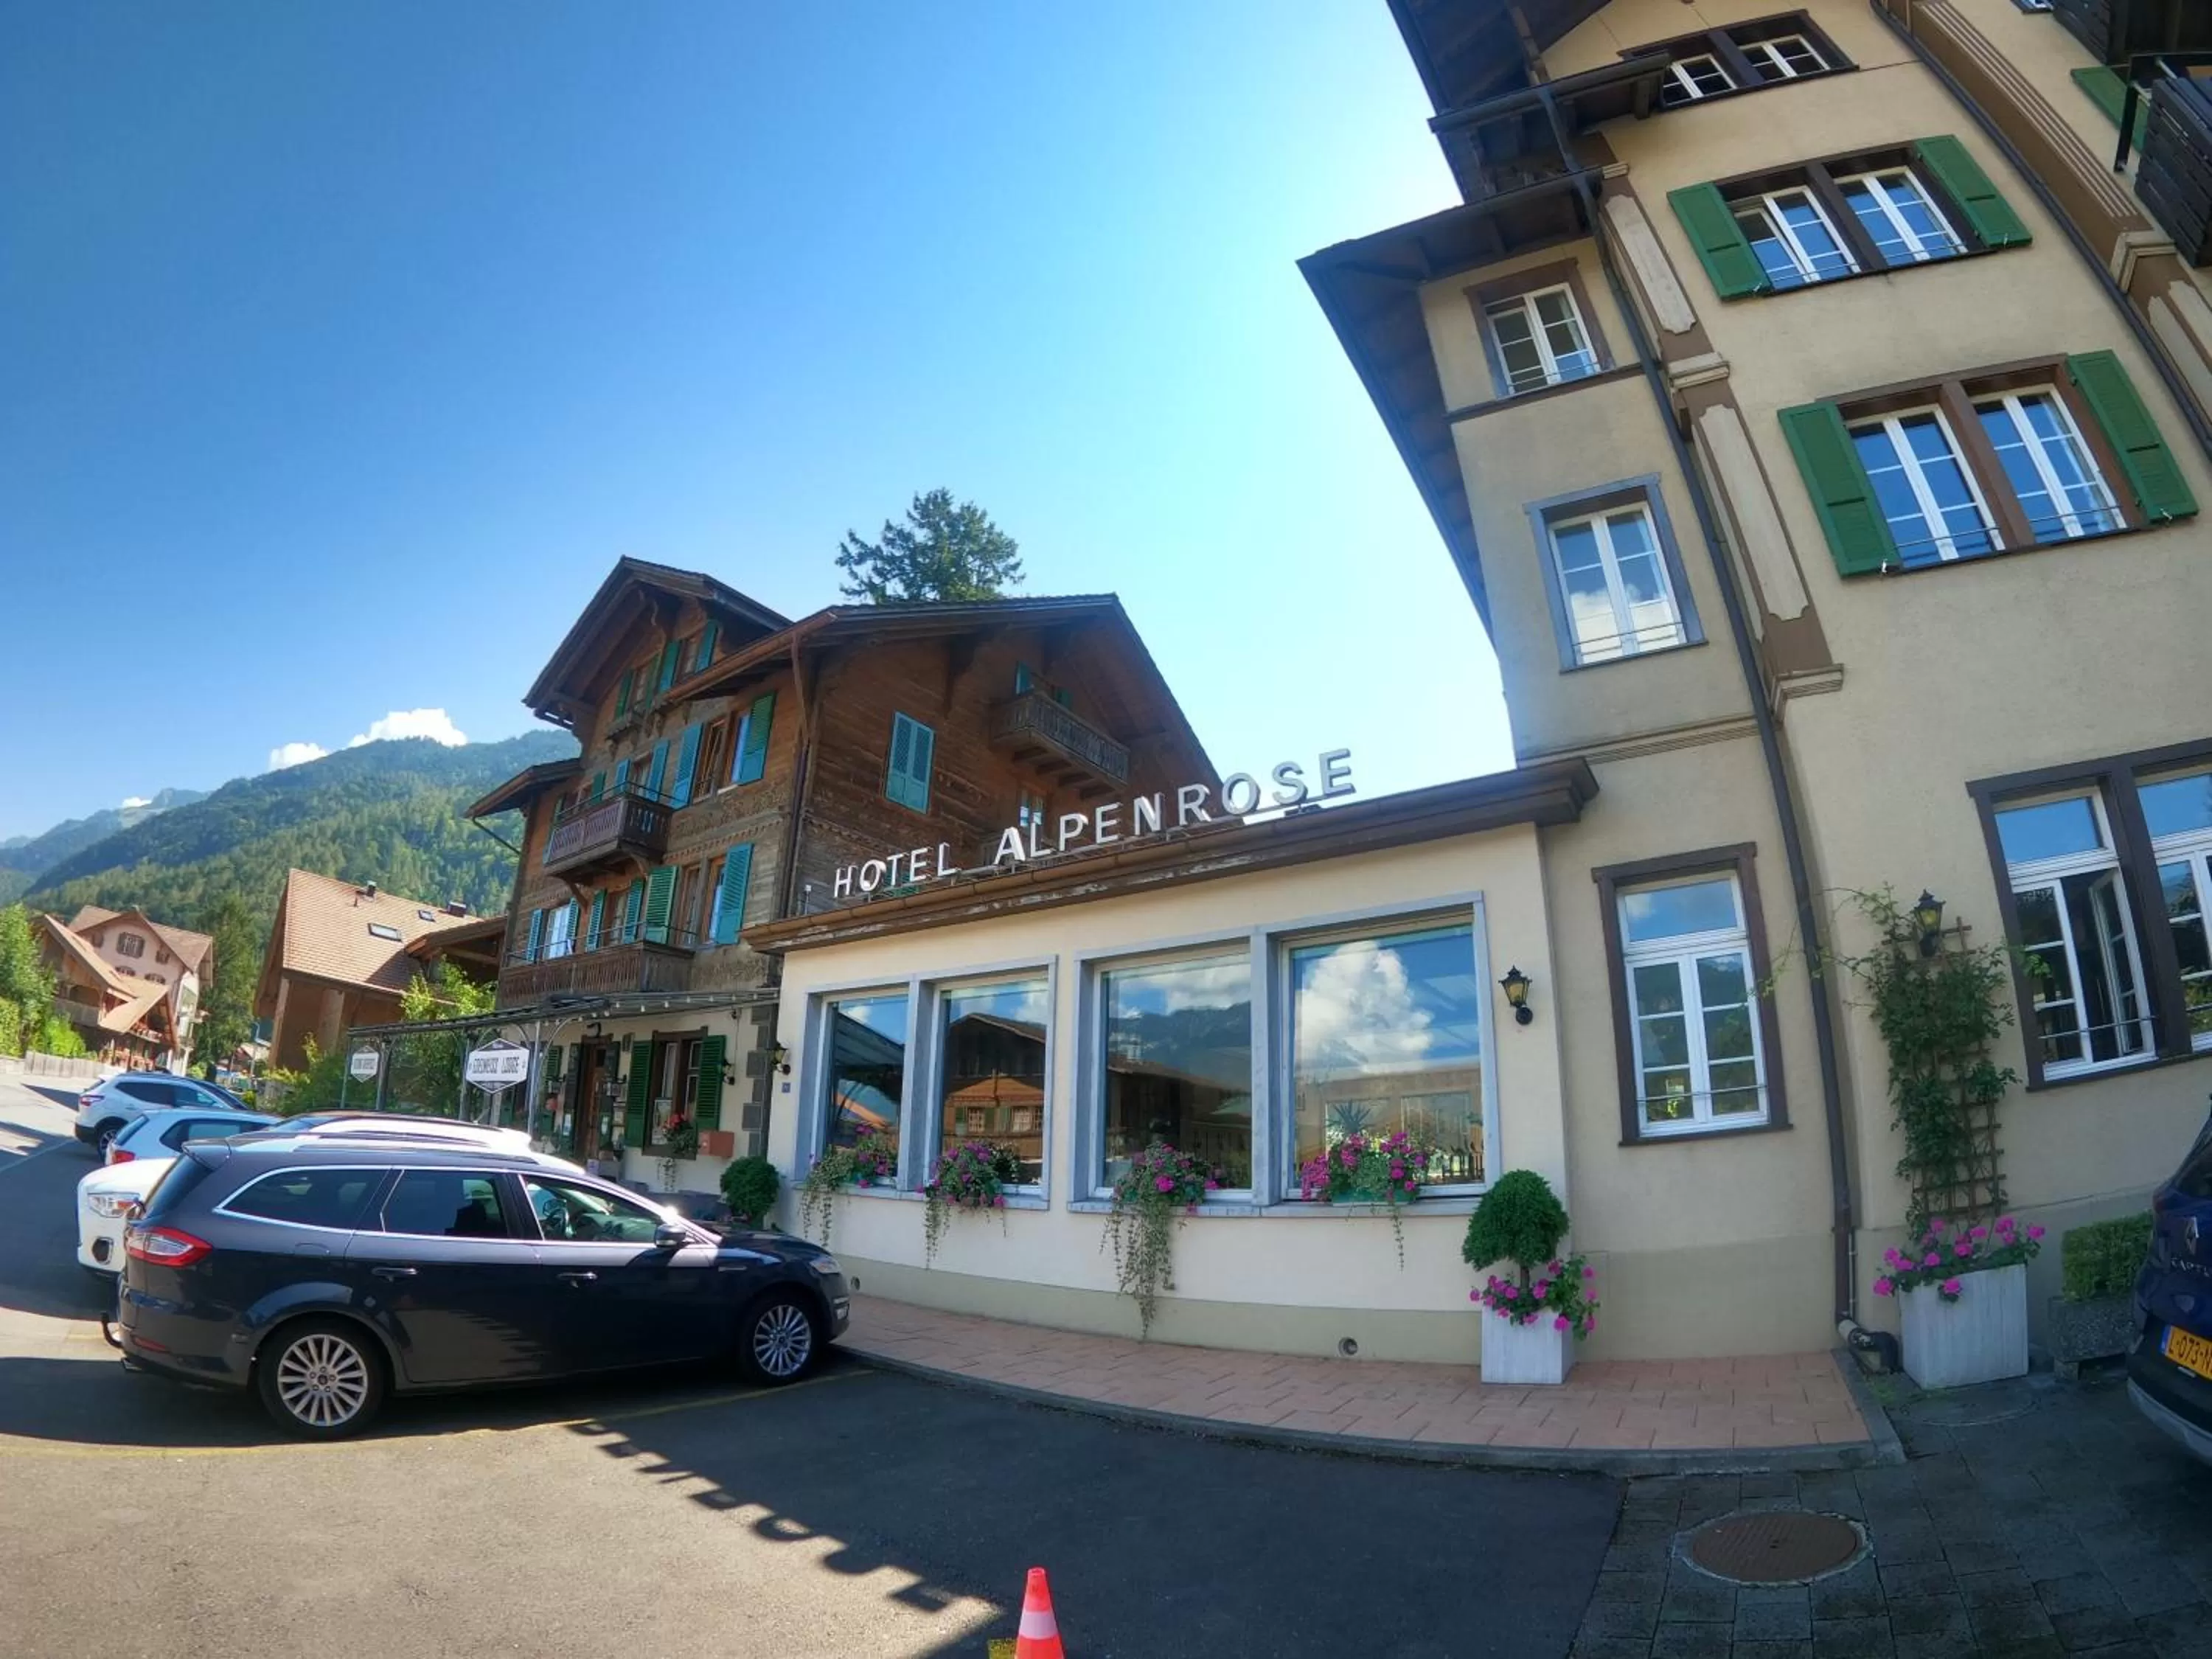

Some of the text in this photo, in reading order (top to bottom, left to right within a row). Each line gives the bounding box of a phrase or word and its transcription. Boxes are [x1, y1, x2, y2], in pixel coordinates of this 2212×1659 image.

[833, 748, 1355, 897] HOTEL ALPENROSE
[2168, 1331, 2212, 1376] L-073-N
